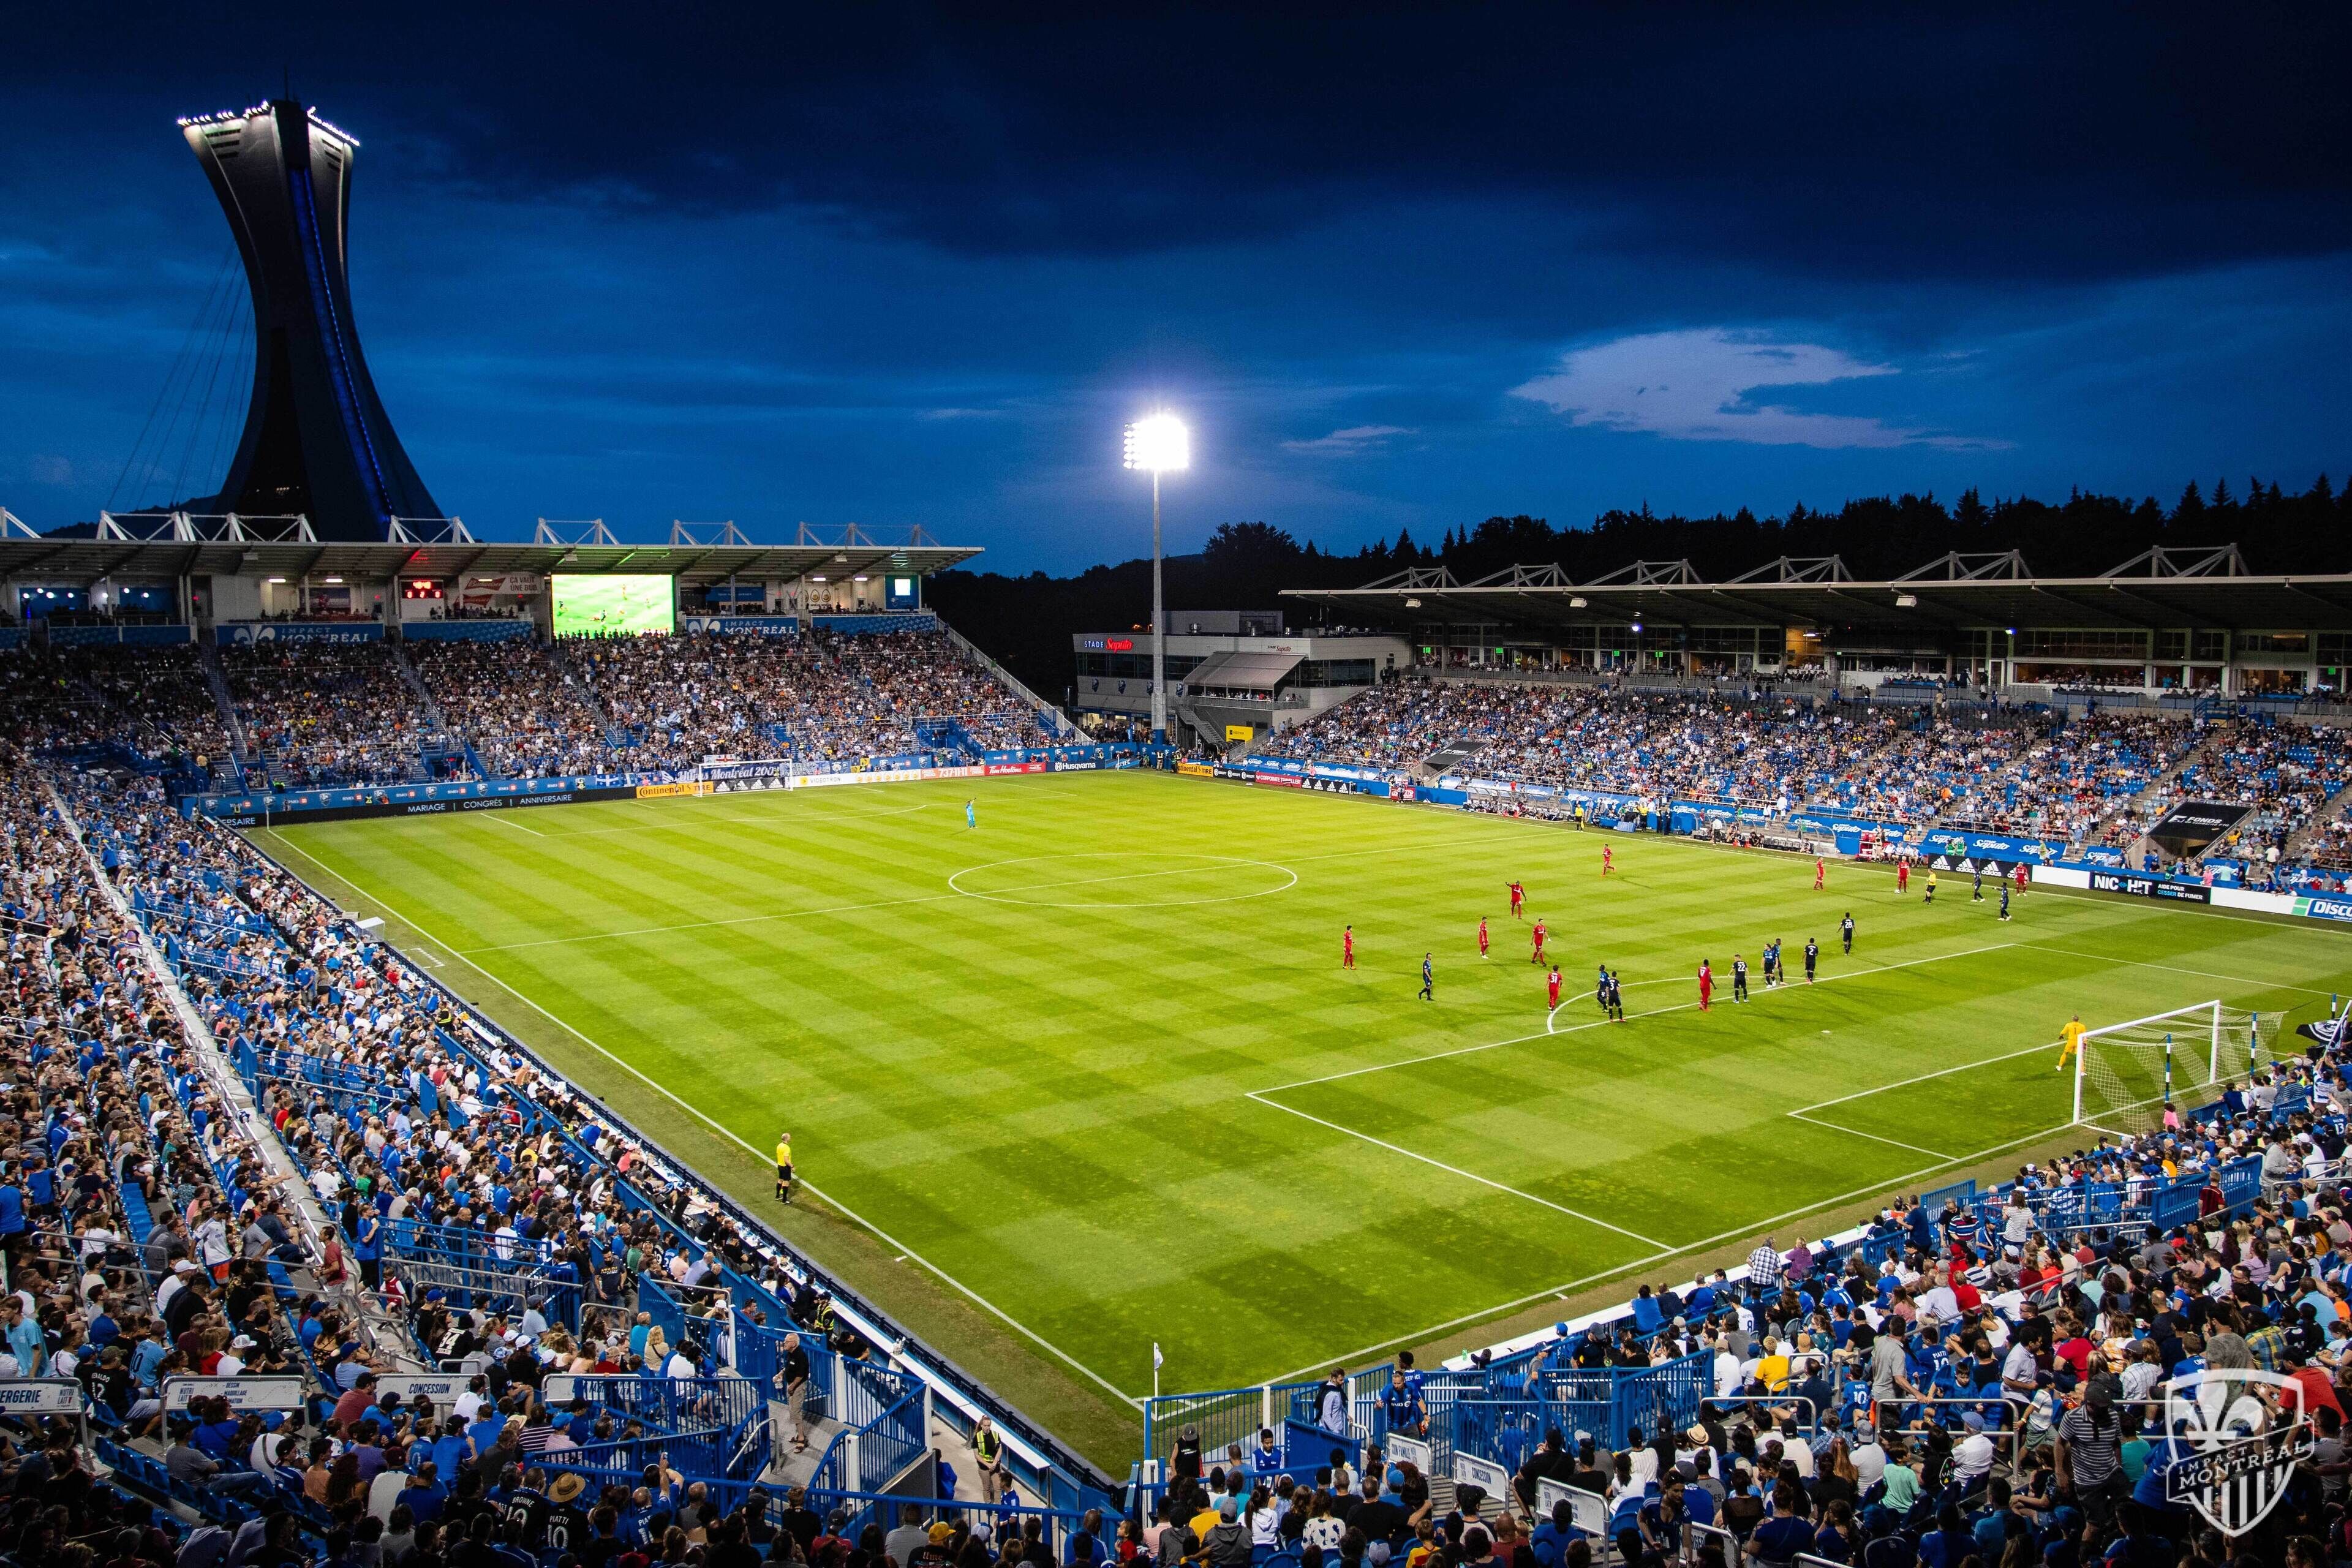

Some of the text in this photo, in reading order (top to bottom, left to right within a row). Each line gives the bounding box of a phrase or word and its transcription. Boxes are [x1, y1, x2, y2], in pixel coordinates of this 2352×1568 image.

[1105, 637, 1133, 654] Saputo
[1062, 762, 1096, 771] Husqvarna
[711, 767, 753, 780] Montréal
[639, 786, 684, 796] Continental
[464, 799, 503, 809] CONGRÈS
[519, 794, 573, 805] ANNIVERSAIRE
[407, 803, 446, 813] MARIAGE
[1972, 839, 2010, 850] Saputo
[2094, 875, 2119, 890] NIC
[1550, 974, 1558, 984] 31
[1610, 982, 1615, 990] 3
[2334, 1123, 2345, 1135] 13
[1839, 1292, 1853, 1305] 11
[1746, 1319, 1753, 1333] 8
[439, 1332, 460, 1350] 94
[1932, 1351, 1947, 1359] PIATTI
[92, 1381, 107, 1403] 12
[409, 1383, 451, 1394] CONCESSION
[1853, 1391, 1867, 1404] 10
[1471, 1466, 1492, 1485] CONCESSION
[512, 1496, 535, 1507] BROWNE
[549, 1515, 570, 1525] PIATTI
[638, 1514, 653, 1526] PIAT
[548, 1524, 568, 1549] 10
